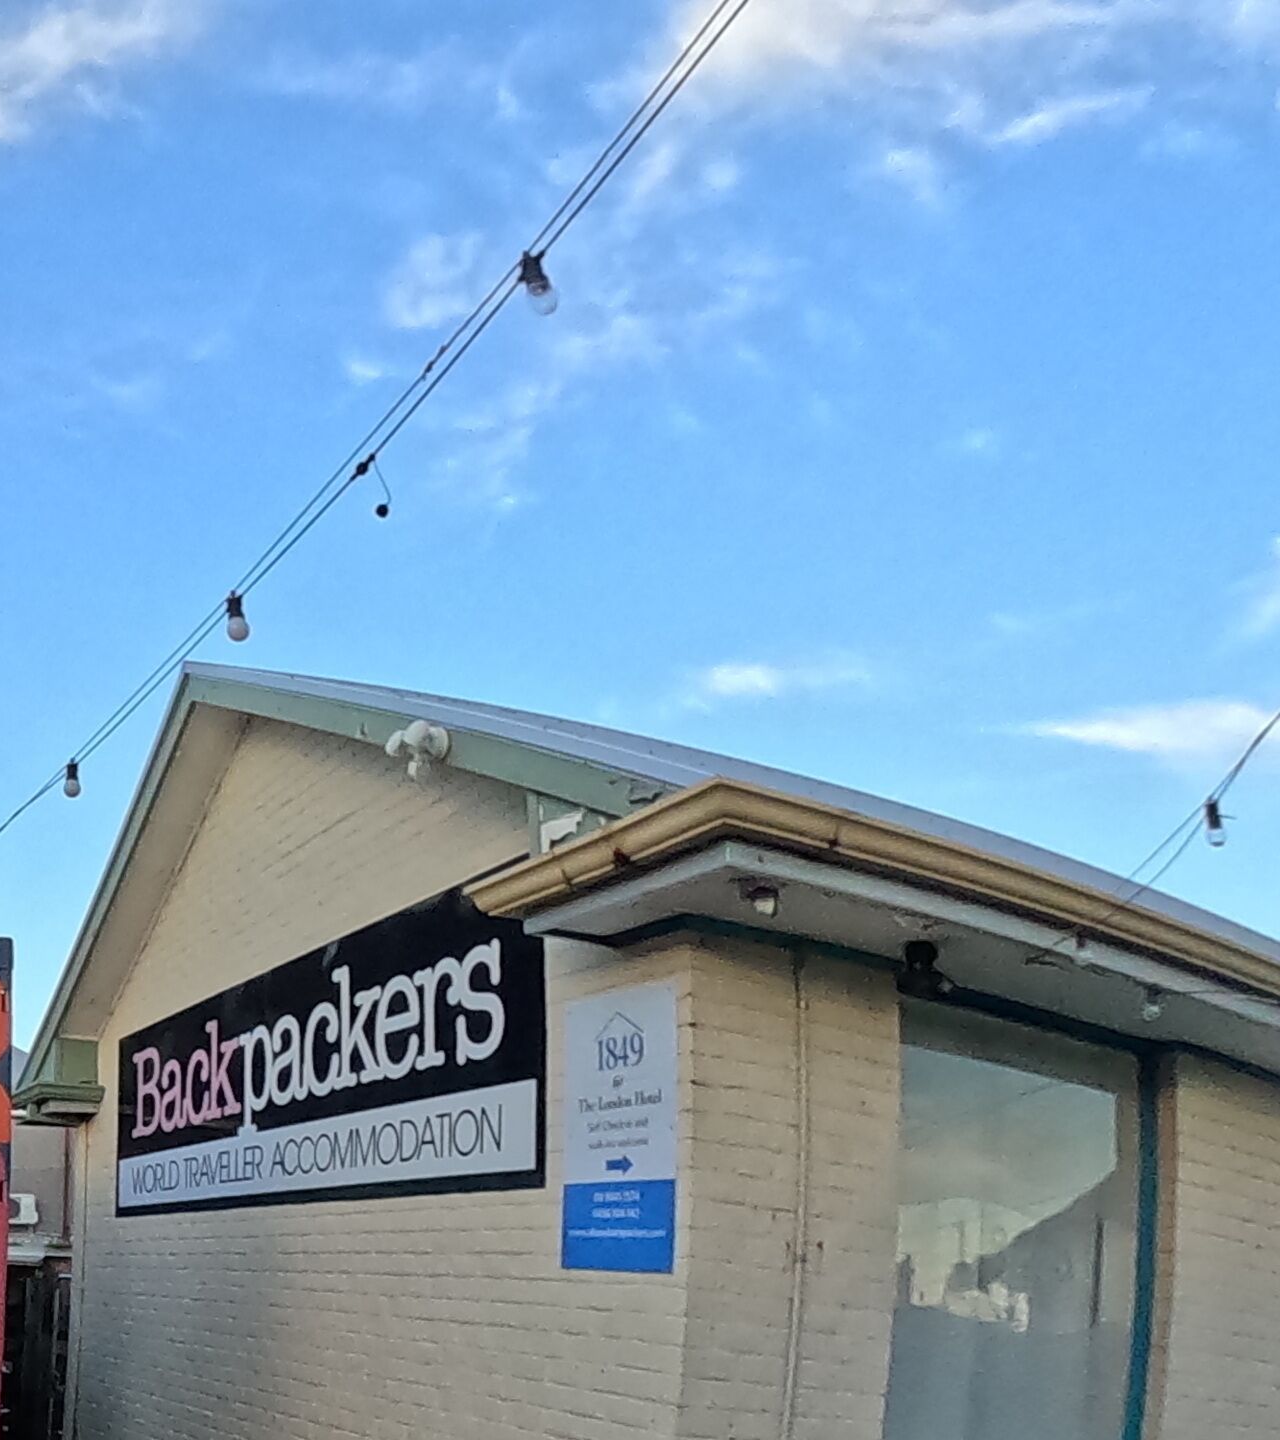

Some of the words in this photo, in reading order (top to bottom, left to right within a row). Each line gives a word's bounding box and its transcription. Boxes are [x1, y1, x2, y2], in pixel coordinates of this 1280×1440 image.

[131, 937, 506, 1138] Backpackers
[597, 1032, 645, 1071] 1849
[131, 1160, 180, 1195] WORLD
[184, 1145, 263, 1188] TRAVELLER
[268, 1104, 503, 1178] ACCOMMODATION
